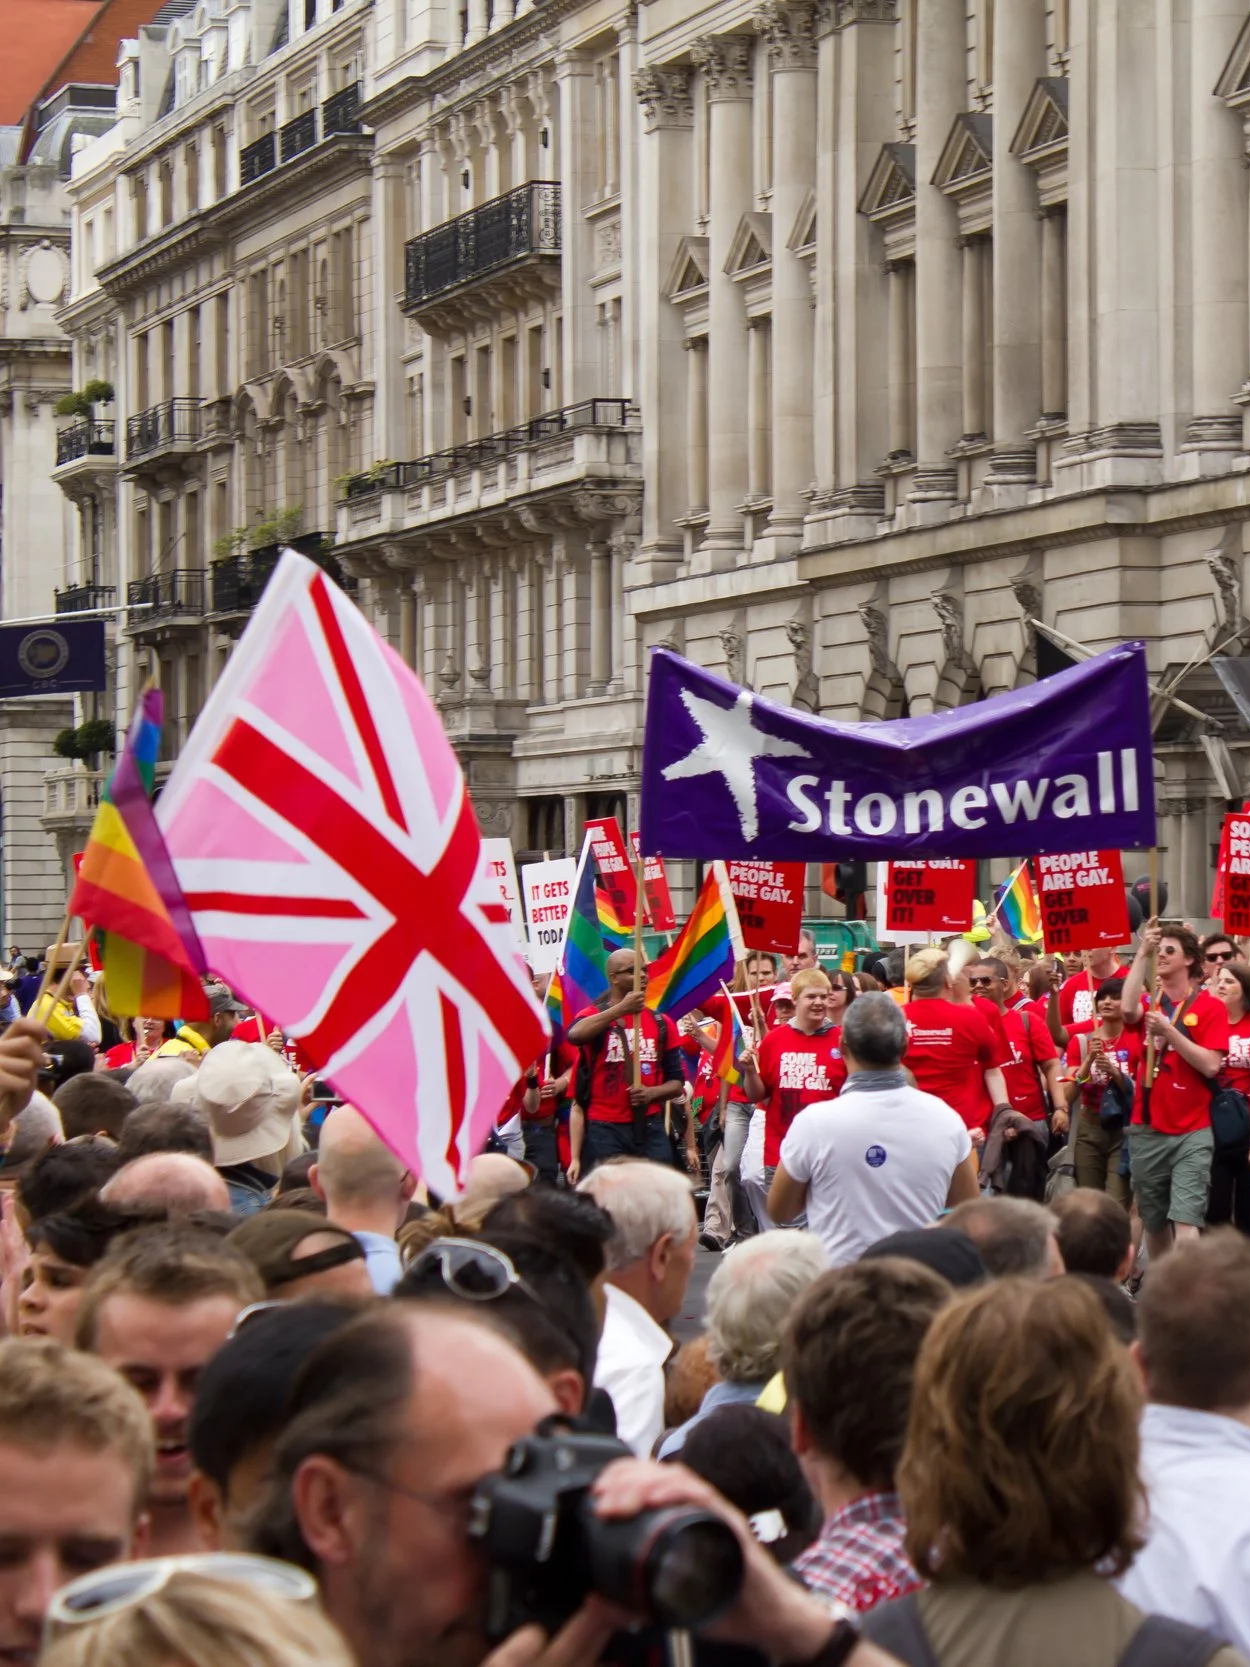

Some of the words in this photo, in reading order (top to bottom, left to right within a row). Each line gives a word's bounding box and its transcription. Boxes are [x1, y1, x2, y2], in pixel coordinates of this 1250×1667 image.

[786, 747, 1141, 836] Stonewall
[1039, 851, 1100, 873] PEOPLE
[730, 866, 784, 887] PEOPLE
[894, 870, 923, 887] GET
[1042, 872, 1074, 891] ARE
[1076, 867, 1114, 887] GAY.
[532, 884, 540, 900] IT
[544, 881, 569, 899] GETS
[730, 881, 757, 898] ARE
[760, 886, 794, 904] GAY.
[893, 889, 935, 906] OVER
[739, 898, 754, 912] ET
[1045, 891, 1074, 908] GET
[741, 914, 765, 929] VER
[892, 907, 914, 923] IT!
[1047, 908, 1089, 926] OVER
[538, 928, 563, 945] TODA
[1050, 928, 1071, 945] IT!
[781, 1052, 817, 1065] SOME
[779, 1062, 826, 1079] PEOPLE
[779, 1076, 804, 1089] ARE
[805, 1076, 832, 1090] GAY.
